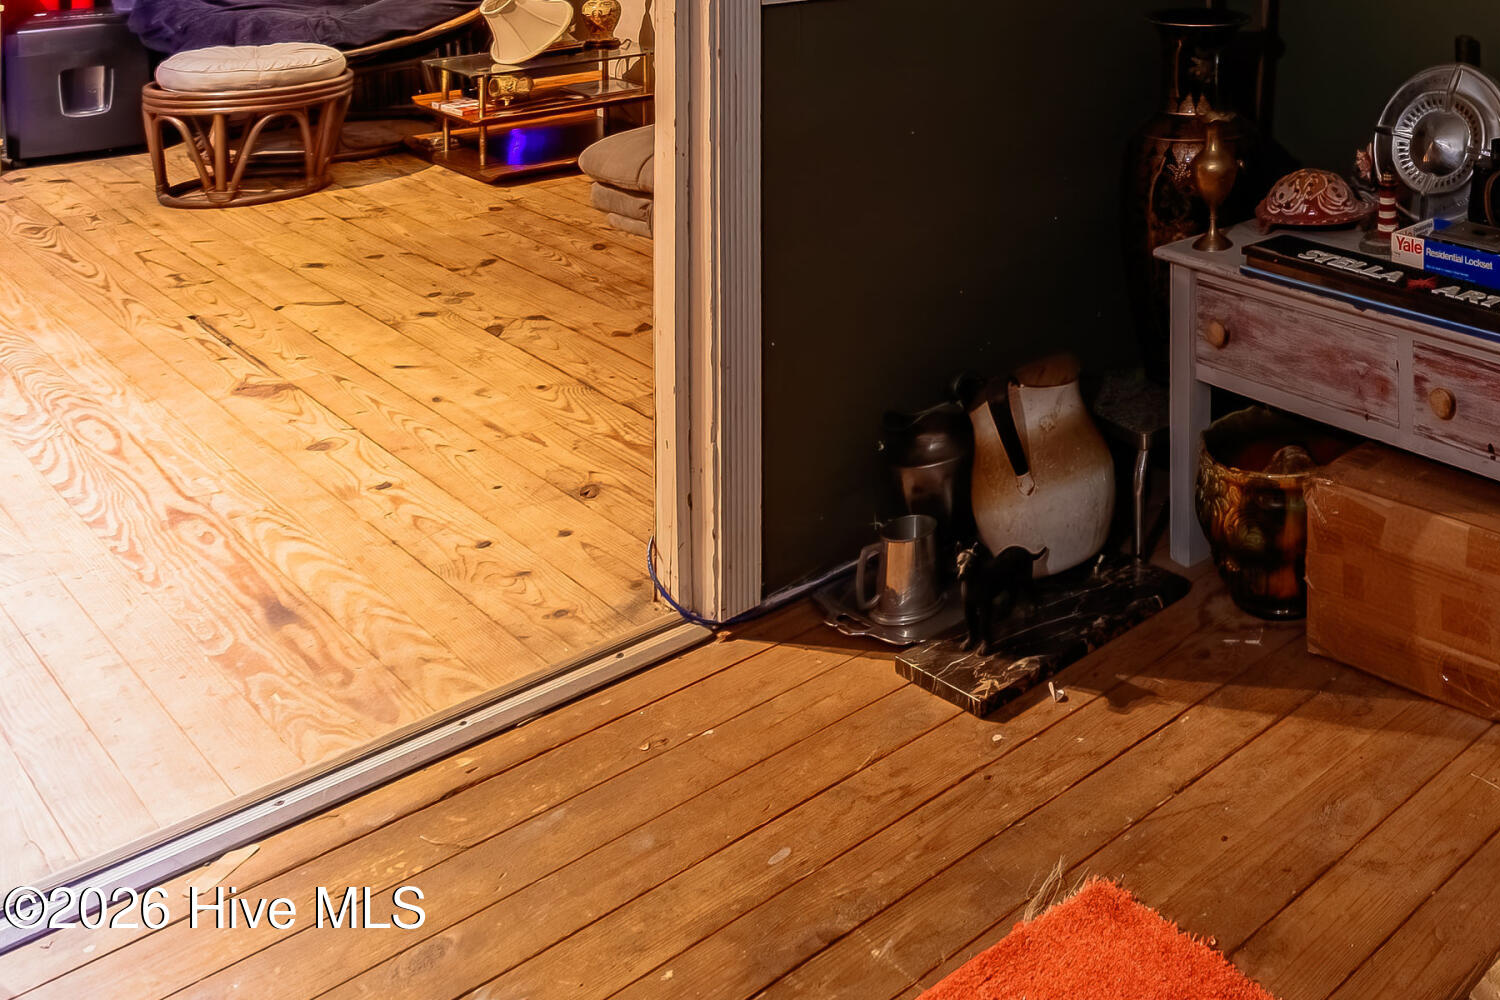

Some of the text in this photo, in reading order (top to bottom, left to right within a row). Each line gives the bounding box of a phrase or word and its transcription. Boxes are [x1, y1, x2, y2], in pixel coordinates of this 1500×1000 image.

[1396, 236, 1423, 255] Yale
[1298, 250, 1404, 283] STELLA
[1425, 247, 1464, 263] Residential
[1464, 256, 1493, 271] Lockset
